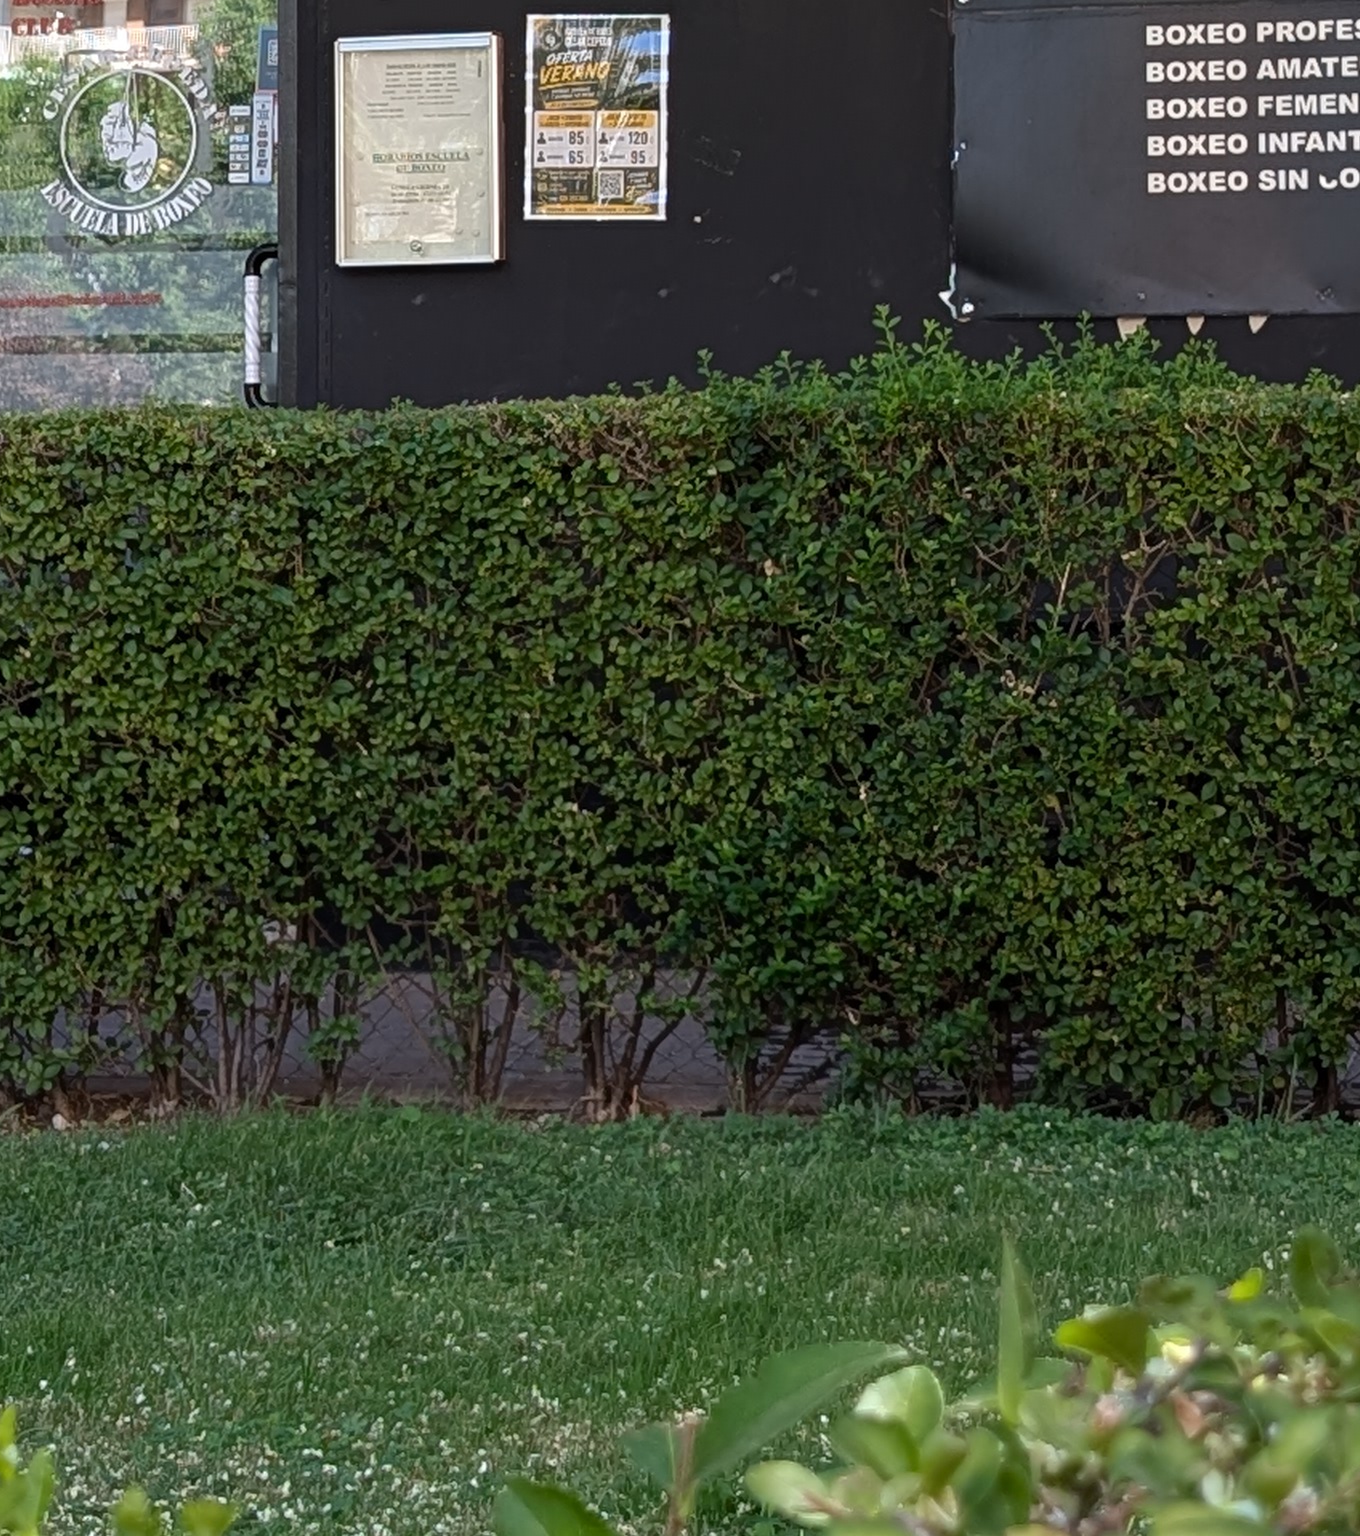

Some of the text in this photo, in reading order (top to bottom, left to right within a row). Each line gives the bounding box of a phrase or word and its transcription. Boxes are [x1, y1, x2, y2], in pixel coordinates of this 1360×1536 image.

[1146, 22, 1247, 46] BOXEO
[545, 49, 594, 66] OFERTA
[539, 61, 611, 84] VERANO
[1146, 59, 1247, 83] BOXEO
[1146, 96, 1248, 120] BOXEO
[568, 131, 584, 145] 85
[628, 131, 649, 145] 120
[1147, 133, 1248, 157] BOXEO
[568, 150, 584, 164] 65
[630, 150, 646, 164] 95
[1147, 170, 1249, 193] BOXEO
[1258, 168, 1309, 191] SIN
[40, 177, 214, 236] ESCUELA DE BOXEO
